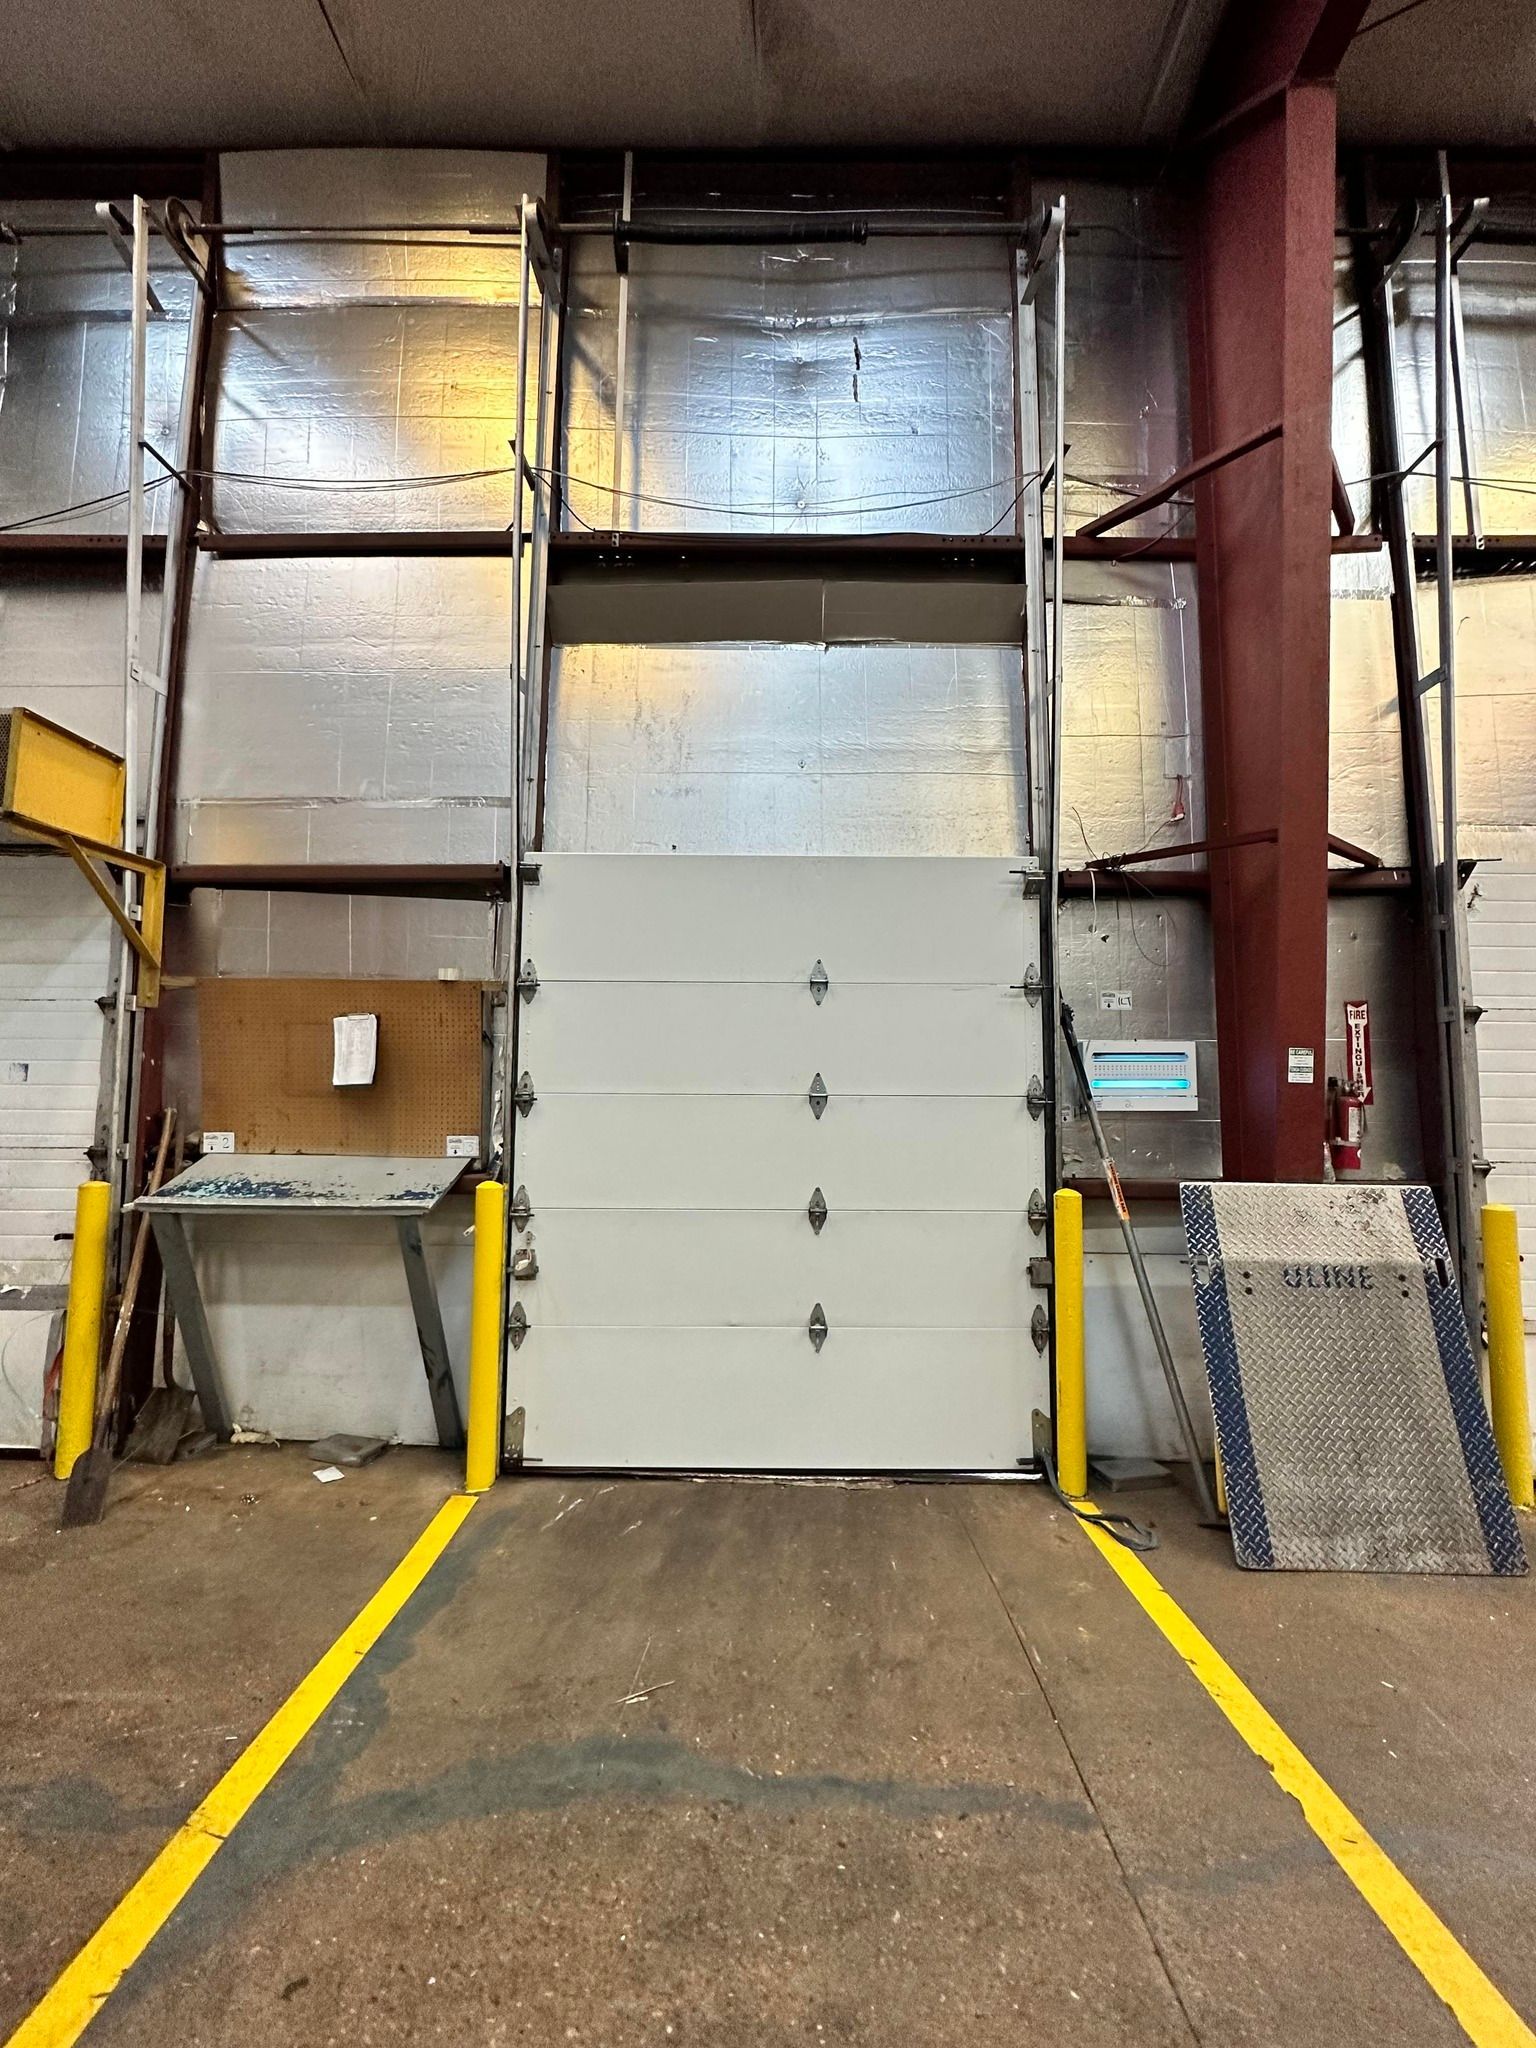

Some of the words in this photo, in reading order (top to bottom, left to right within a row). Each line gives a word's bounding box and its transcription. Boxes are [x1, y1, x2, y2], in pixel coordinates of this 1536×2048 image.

[1349, 1010, 1366, 1020] FIRE
[1354, 1023, 1365, 1098] EXTINGUISHER
[222, 1137, 230, 1149] 2
[1283, 1264, 1374, 1290] ULINE
